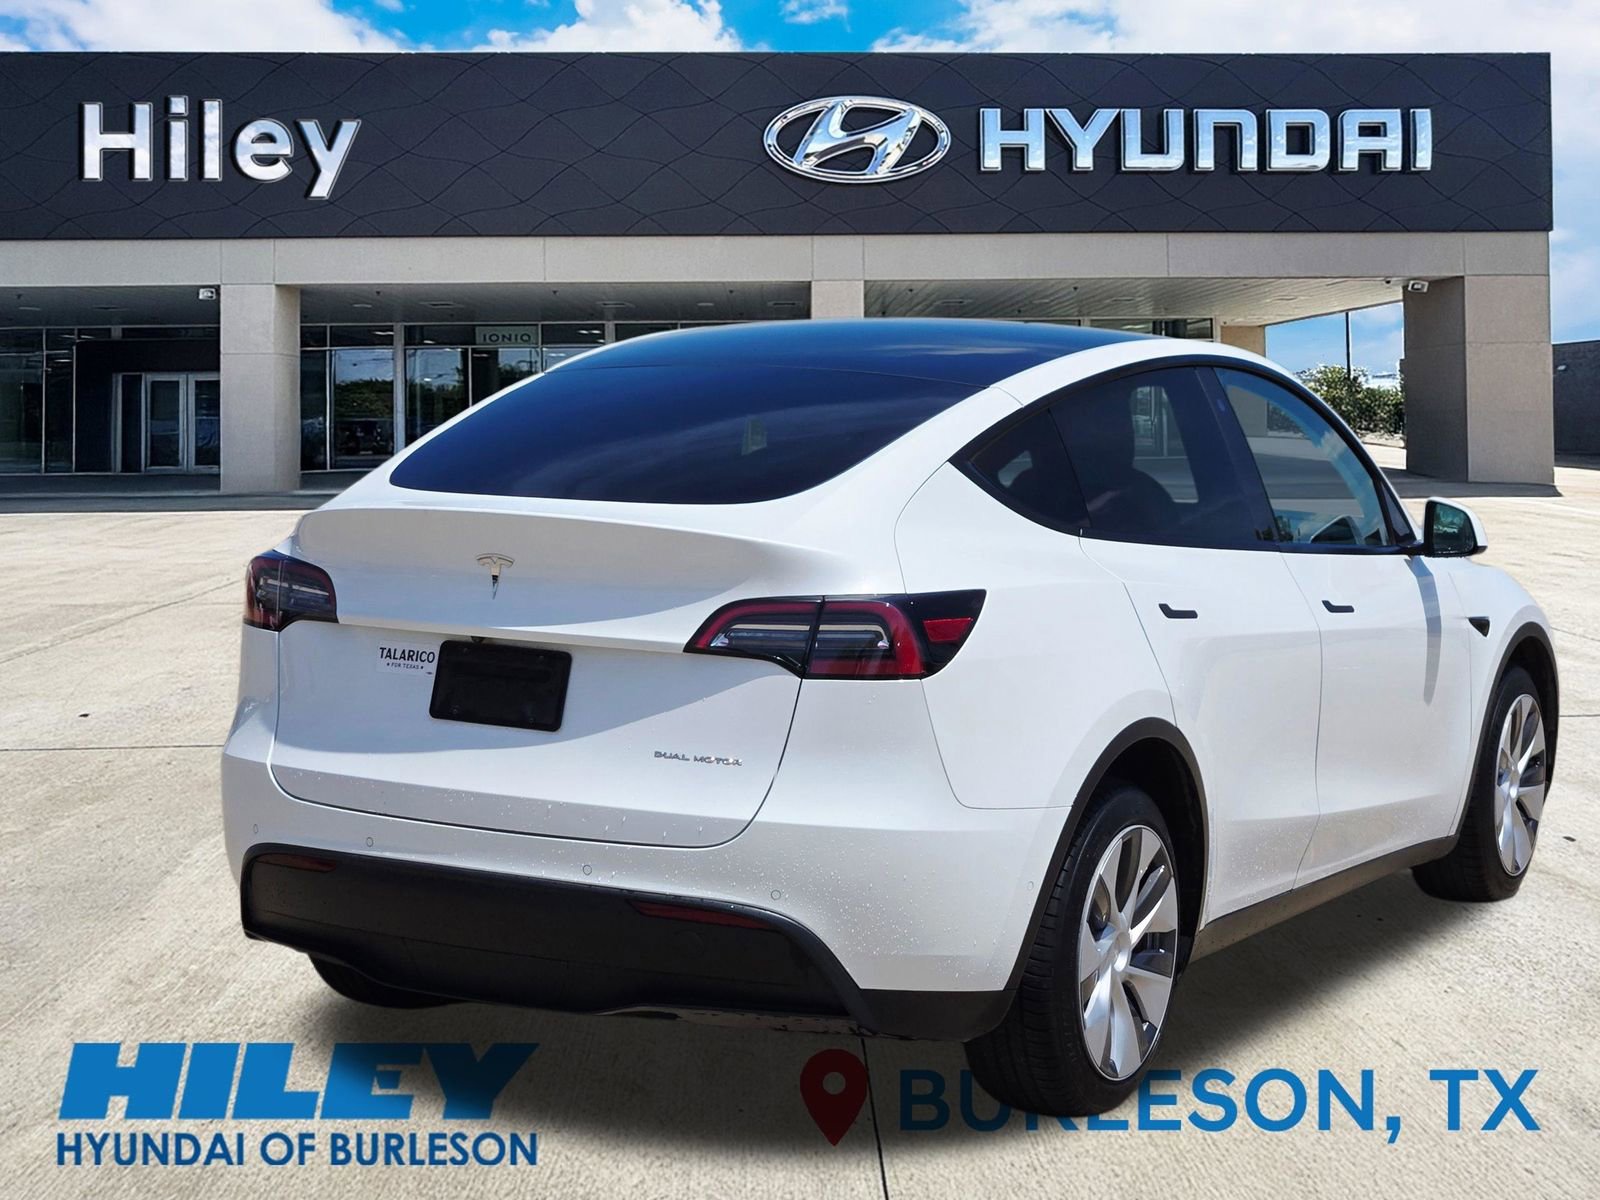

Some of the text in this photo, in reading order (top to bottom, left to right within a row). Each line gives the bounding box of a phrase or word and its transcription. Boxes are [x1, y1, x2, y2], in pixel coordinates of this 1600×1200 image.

[80, 95, 362, 200] Hiley
[979, 107, 1433, 172] HYUNDAI
[482, 333, 532, 343] IONIQ
[379, 646, 436, 664] TALARICO
[653, 751, 743, 766] DUAL MOTOR
